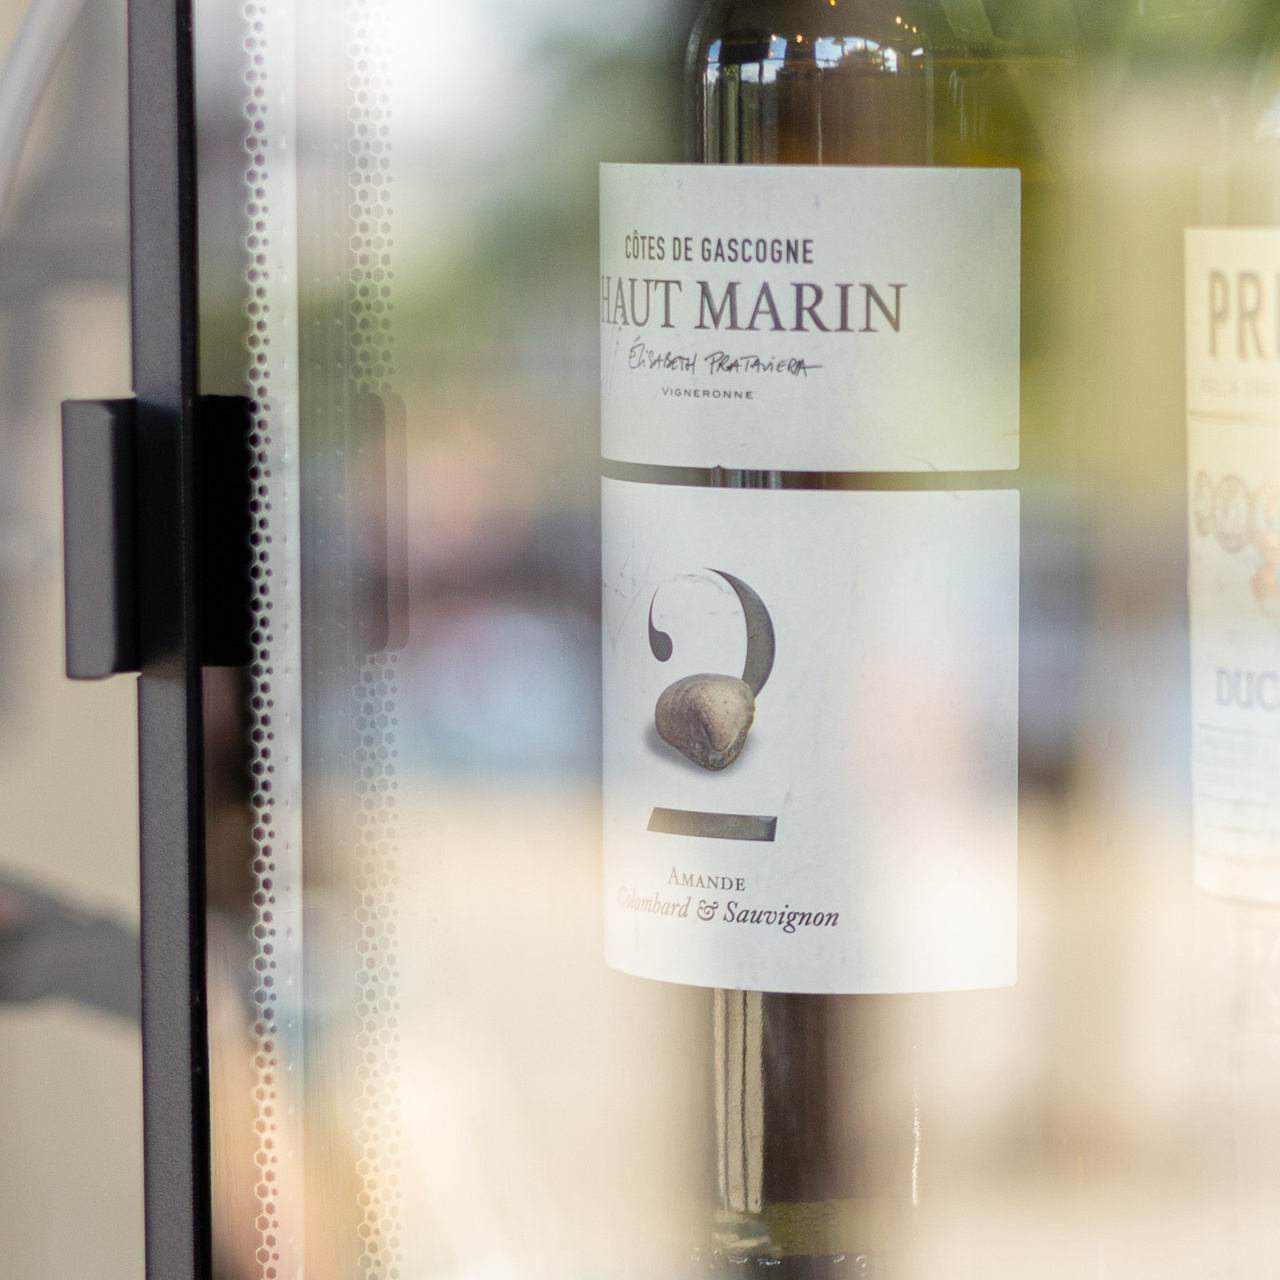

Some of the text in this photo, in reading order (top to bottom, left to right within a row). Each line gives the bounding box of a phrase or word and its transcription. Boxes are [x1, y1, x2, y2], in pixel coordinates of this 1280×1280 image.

[624, 230, 814, 264] CÔTES DE GASCOGNE
[601, 275, 908, 333] HAUT MARIN
[617, 885, 840, 934] Colombard & Sauvignon
